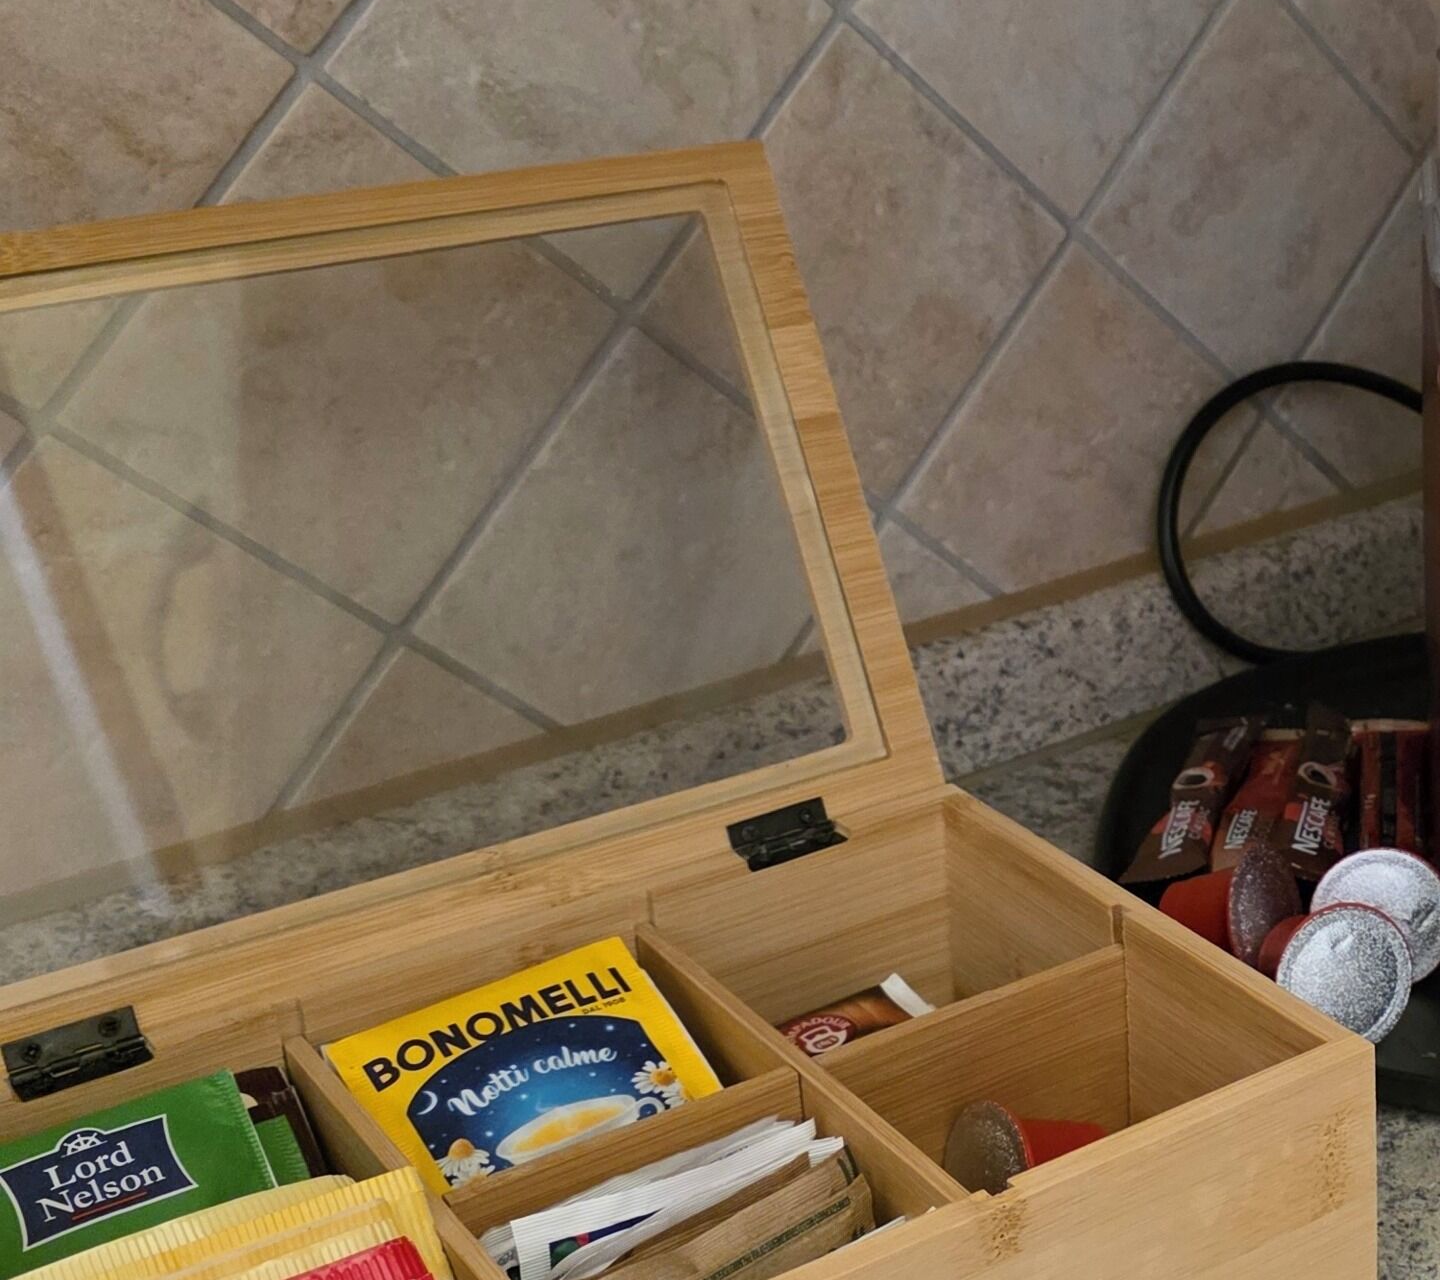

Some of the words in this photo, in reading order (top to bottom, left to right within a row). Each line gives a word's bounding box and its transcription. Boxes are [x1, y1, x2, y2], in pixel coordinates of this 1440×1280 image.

[362, 967, 632, 1093] BONOMELLI
[447, 1064, 531, 1116] Notti
[533, 1046, 618, 1074] calme
[35, 1165, 167, 1223] Nelson
[42, 1141, 136, 1191] Lord
